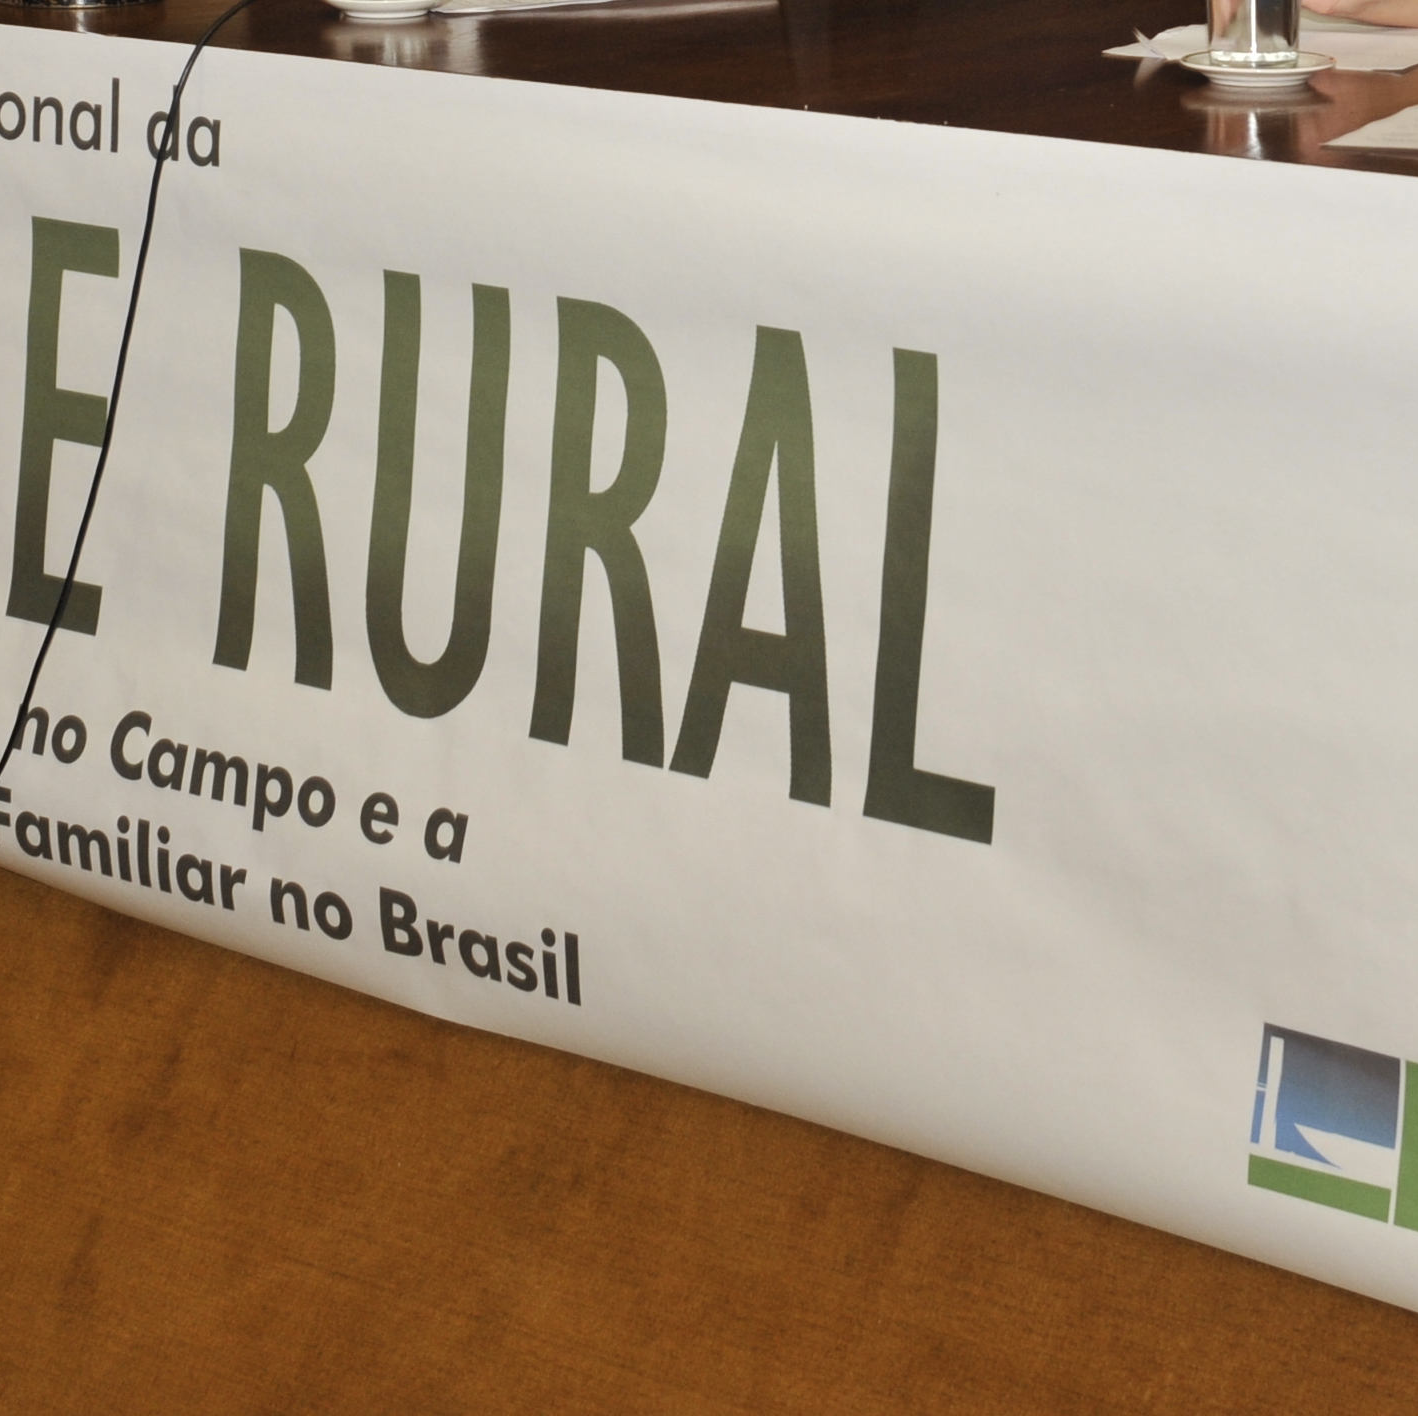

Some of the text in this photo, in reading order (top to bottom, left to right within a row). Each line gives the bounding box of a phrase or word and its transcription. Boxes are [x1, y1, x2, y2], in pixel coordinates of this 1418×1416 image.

[146, 84, 222, 168] da
[212, 246, 996, 846] RURAL
[12, 702, 89, 765] no
[109, 710, 337, 832] Campo
[359, 790, 400, 845] e
[422, 806, 470, 865] a
[269, 877, 354, 942] no
[378, 886, 582, 1007] Brasil
